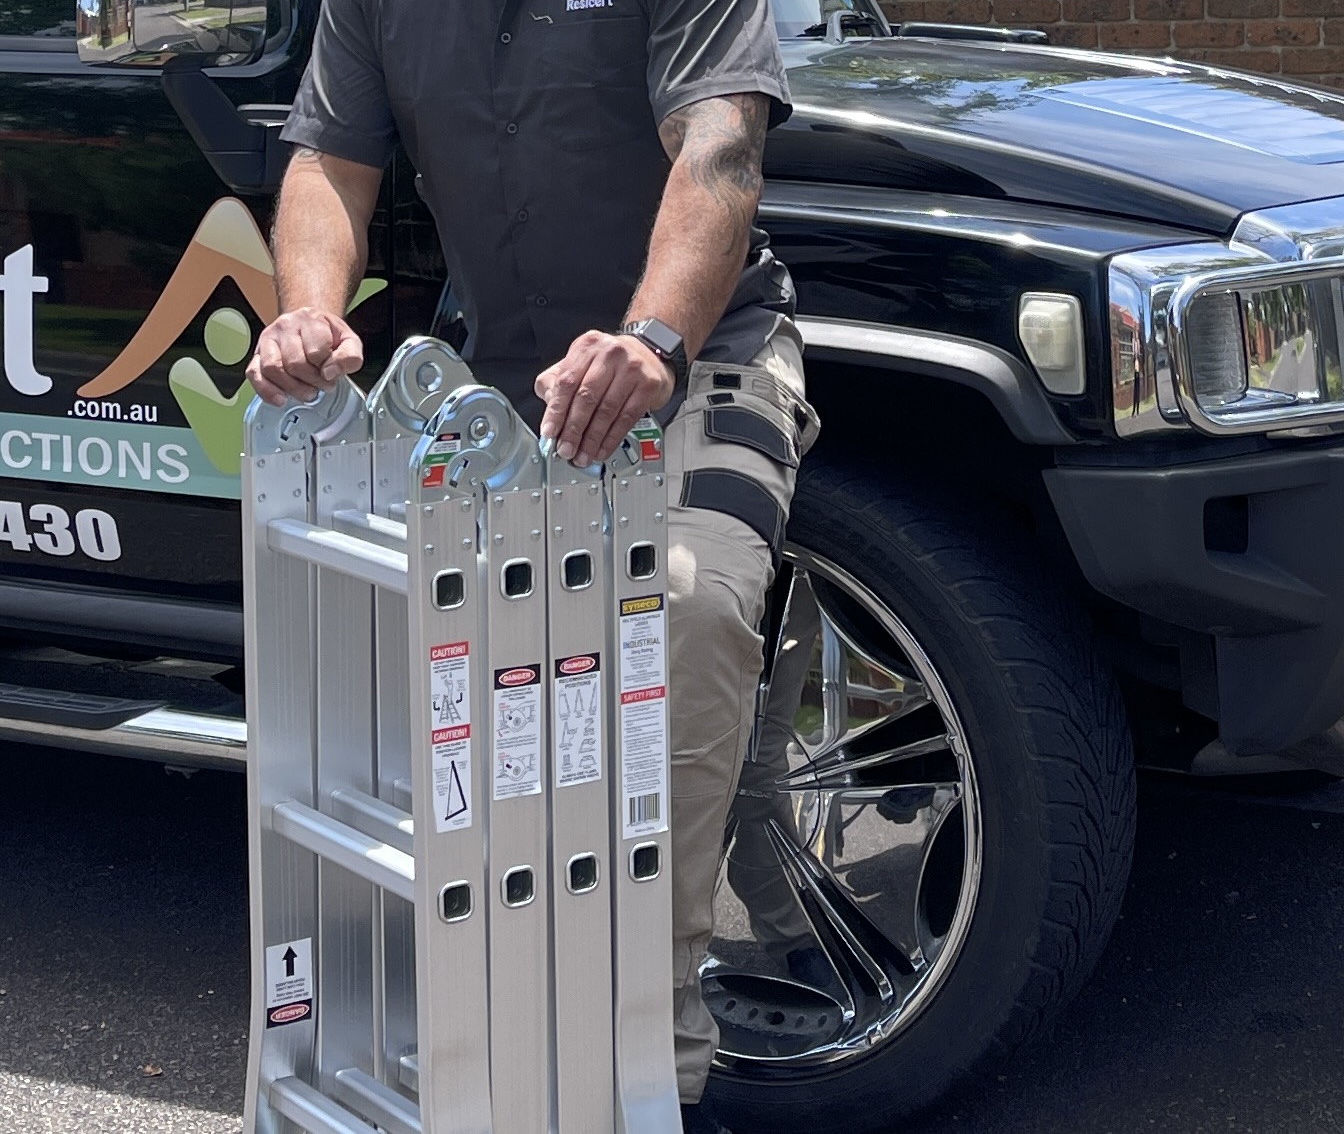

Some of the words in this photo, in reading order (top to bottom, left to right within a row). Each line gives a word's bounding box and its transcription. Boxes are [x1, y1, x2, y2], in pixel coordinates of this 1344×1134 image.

[66, 400, 158, 424] .com.au
[431, 644, 466, 659] CAUTION!
[433, 727, 468, 743] CAUTION!
